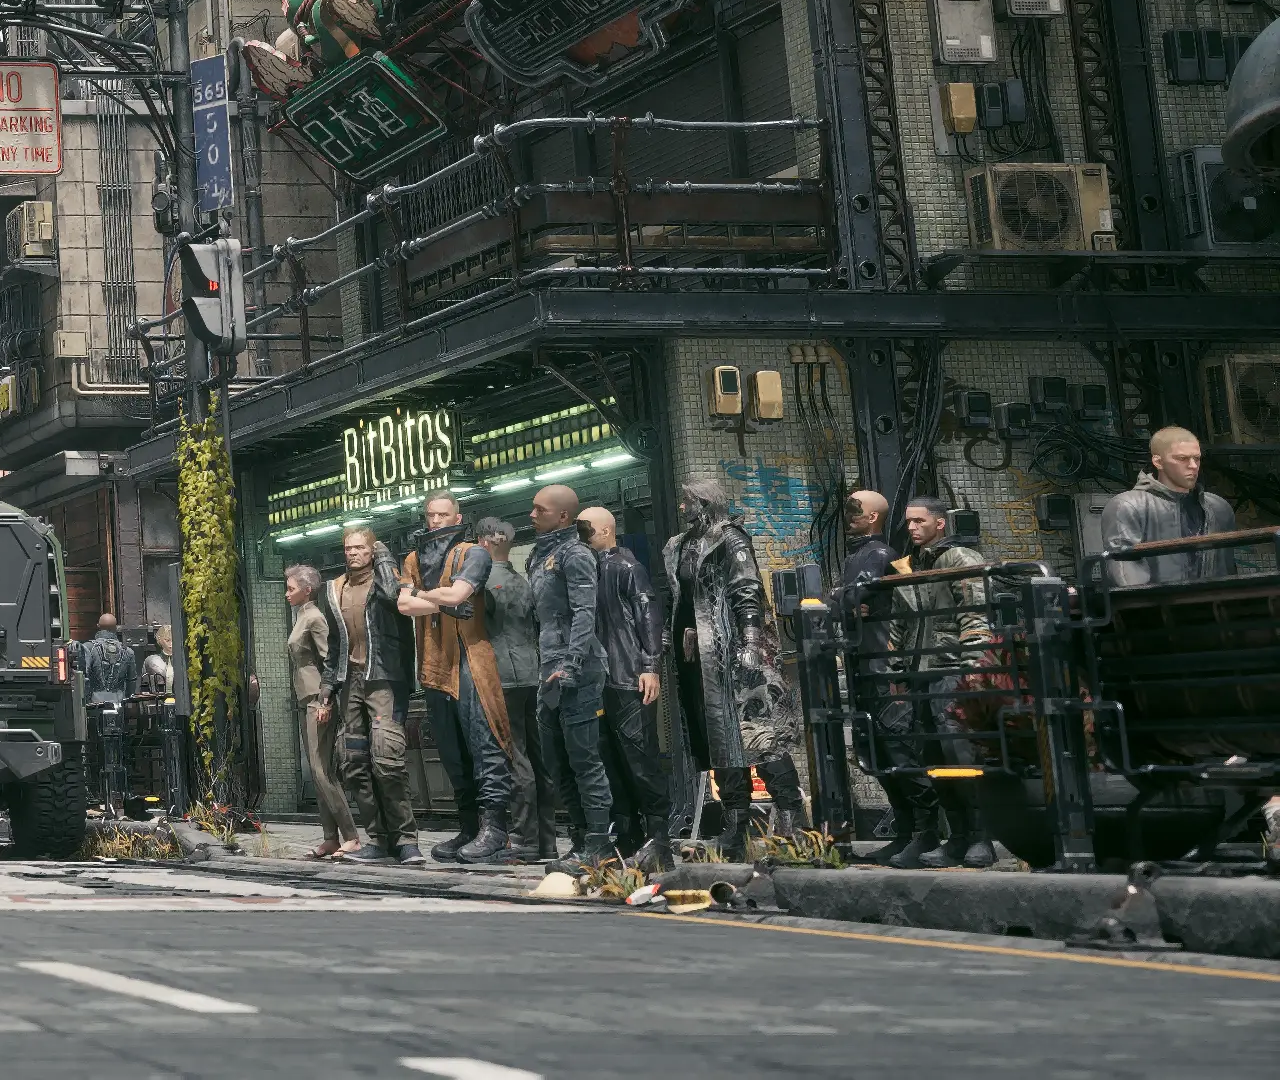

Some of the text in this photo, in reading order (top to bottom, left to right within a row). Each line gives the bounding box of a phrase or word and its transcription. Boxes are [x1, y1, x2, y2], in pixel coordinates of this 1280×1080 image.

[193, 80, 225, 104] 565
[23, 146, 53, 163] TIME
[343, 406, 452, 494] BitBites
